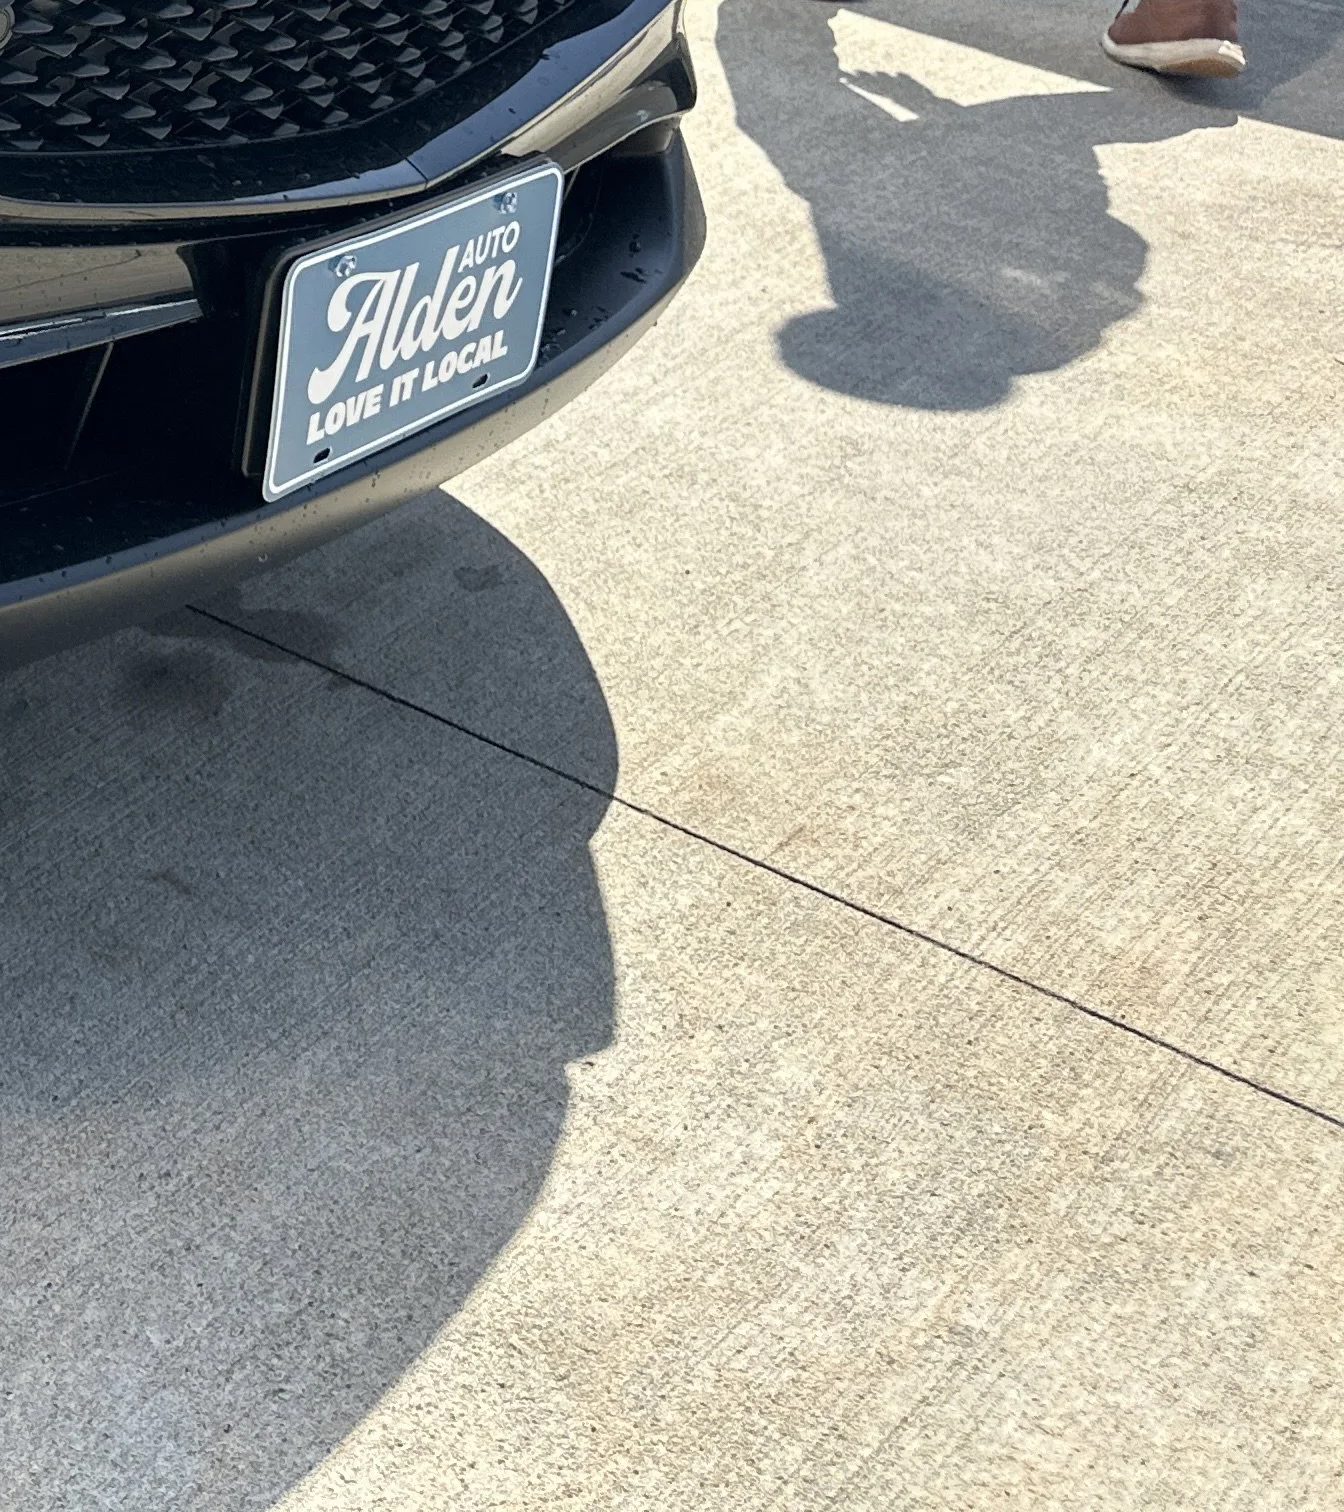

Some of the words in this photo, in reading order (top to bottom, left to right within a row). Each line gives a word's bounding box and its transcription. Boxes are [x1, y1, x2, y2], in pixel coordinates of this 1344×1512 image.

[457, 220, 521, 273] AUTO
[307, 244, 523, 405] Alden
[306, 384, 385, 445] LOVE
[389, 369, 420, 408] IT
[421, 330, 508, 391] LOCAL
